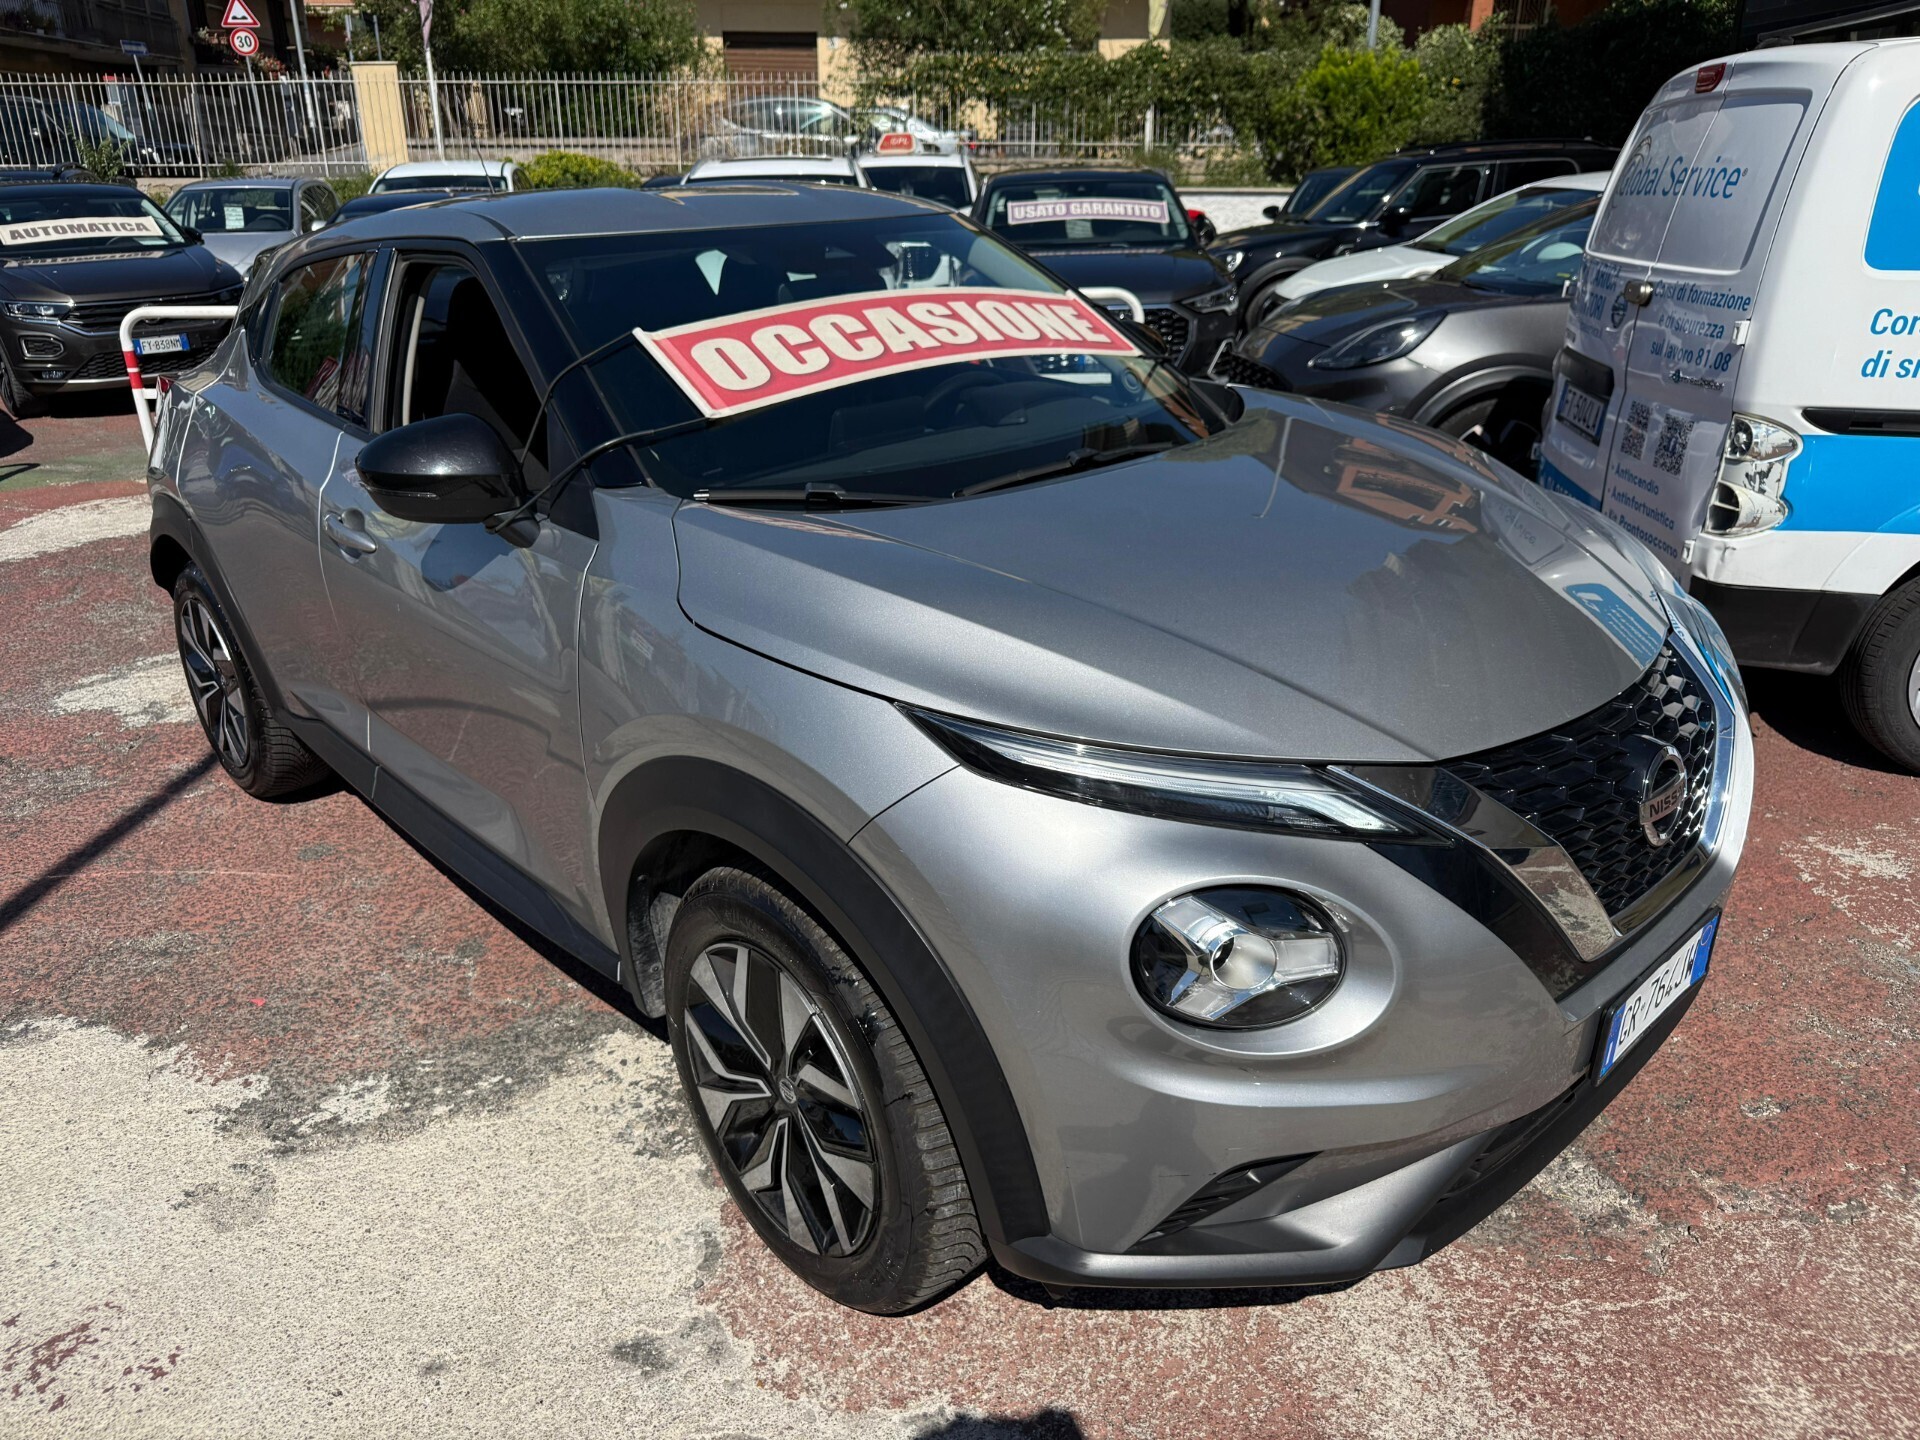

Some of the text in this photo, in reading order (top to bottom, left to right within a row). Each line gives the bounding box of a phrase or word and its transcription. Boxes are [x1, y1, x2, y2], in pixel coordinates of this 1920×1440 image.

[236, 35, 251, 48] 30
[1014, 201, 1162, 219] USATO GARANTITO
[9, 222, 151, 241] AUTOMATICA
[1677, 281, 1688, 301] di
[1686, 283, 1751, 312] formazione
[1674, 312, 1725, 339] sicurezza
[1870, 308, 1920, 335] Cor
[690, 300, 1112, 391] OCCASIONE
[1650, 339, 1732, 372] sul lavoro 81.08
[1861, 350, 1893, 378] di
[1614, 462, 1659, 496] Antincendio
[1611, 486, 1675, 531] Antinfortunistica
[1618, 513, 1678, 559] Prontosoccorso
